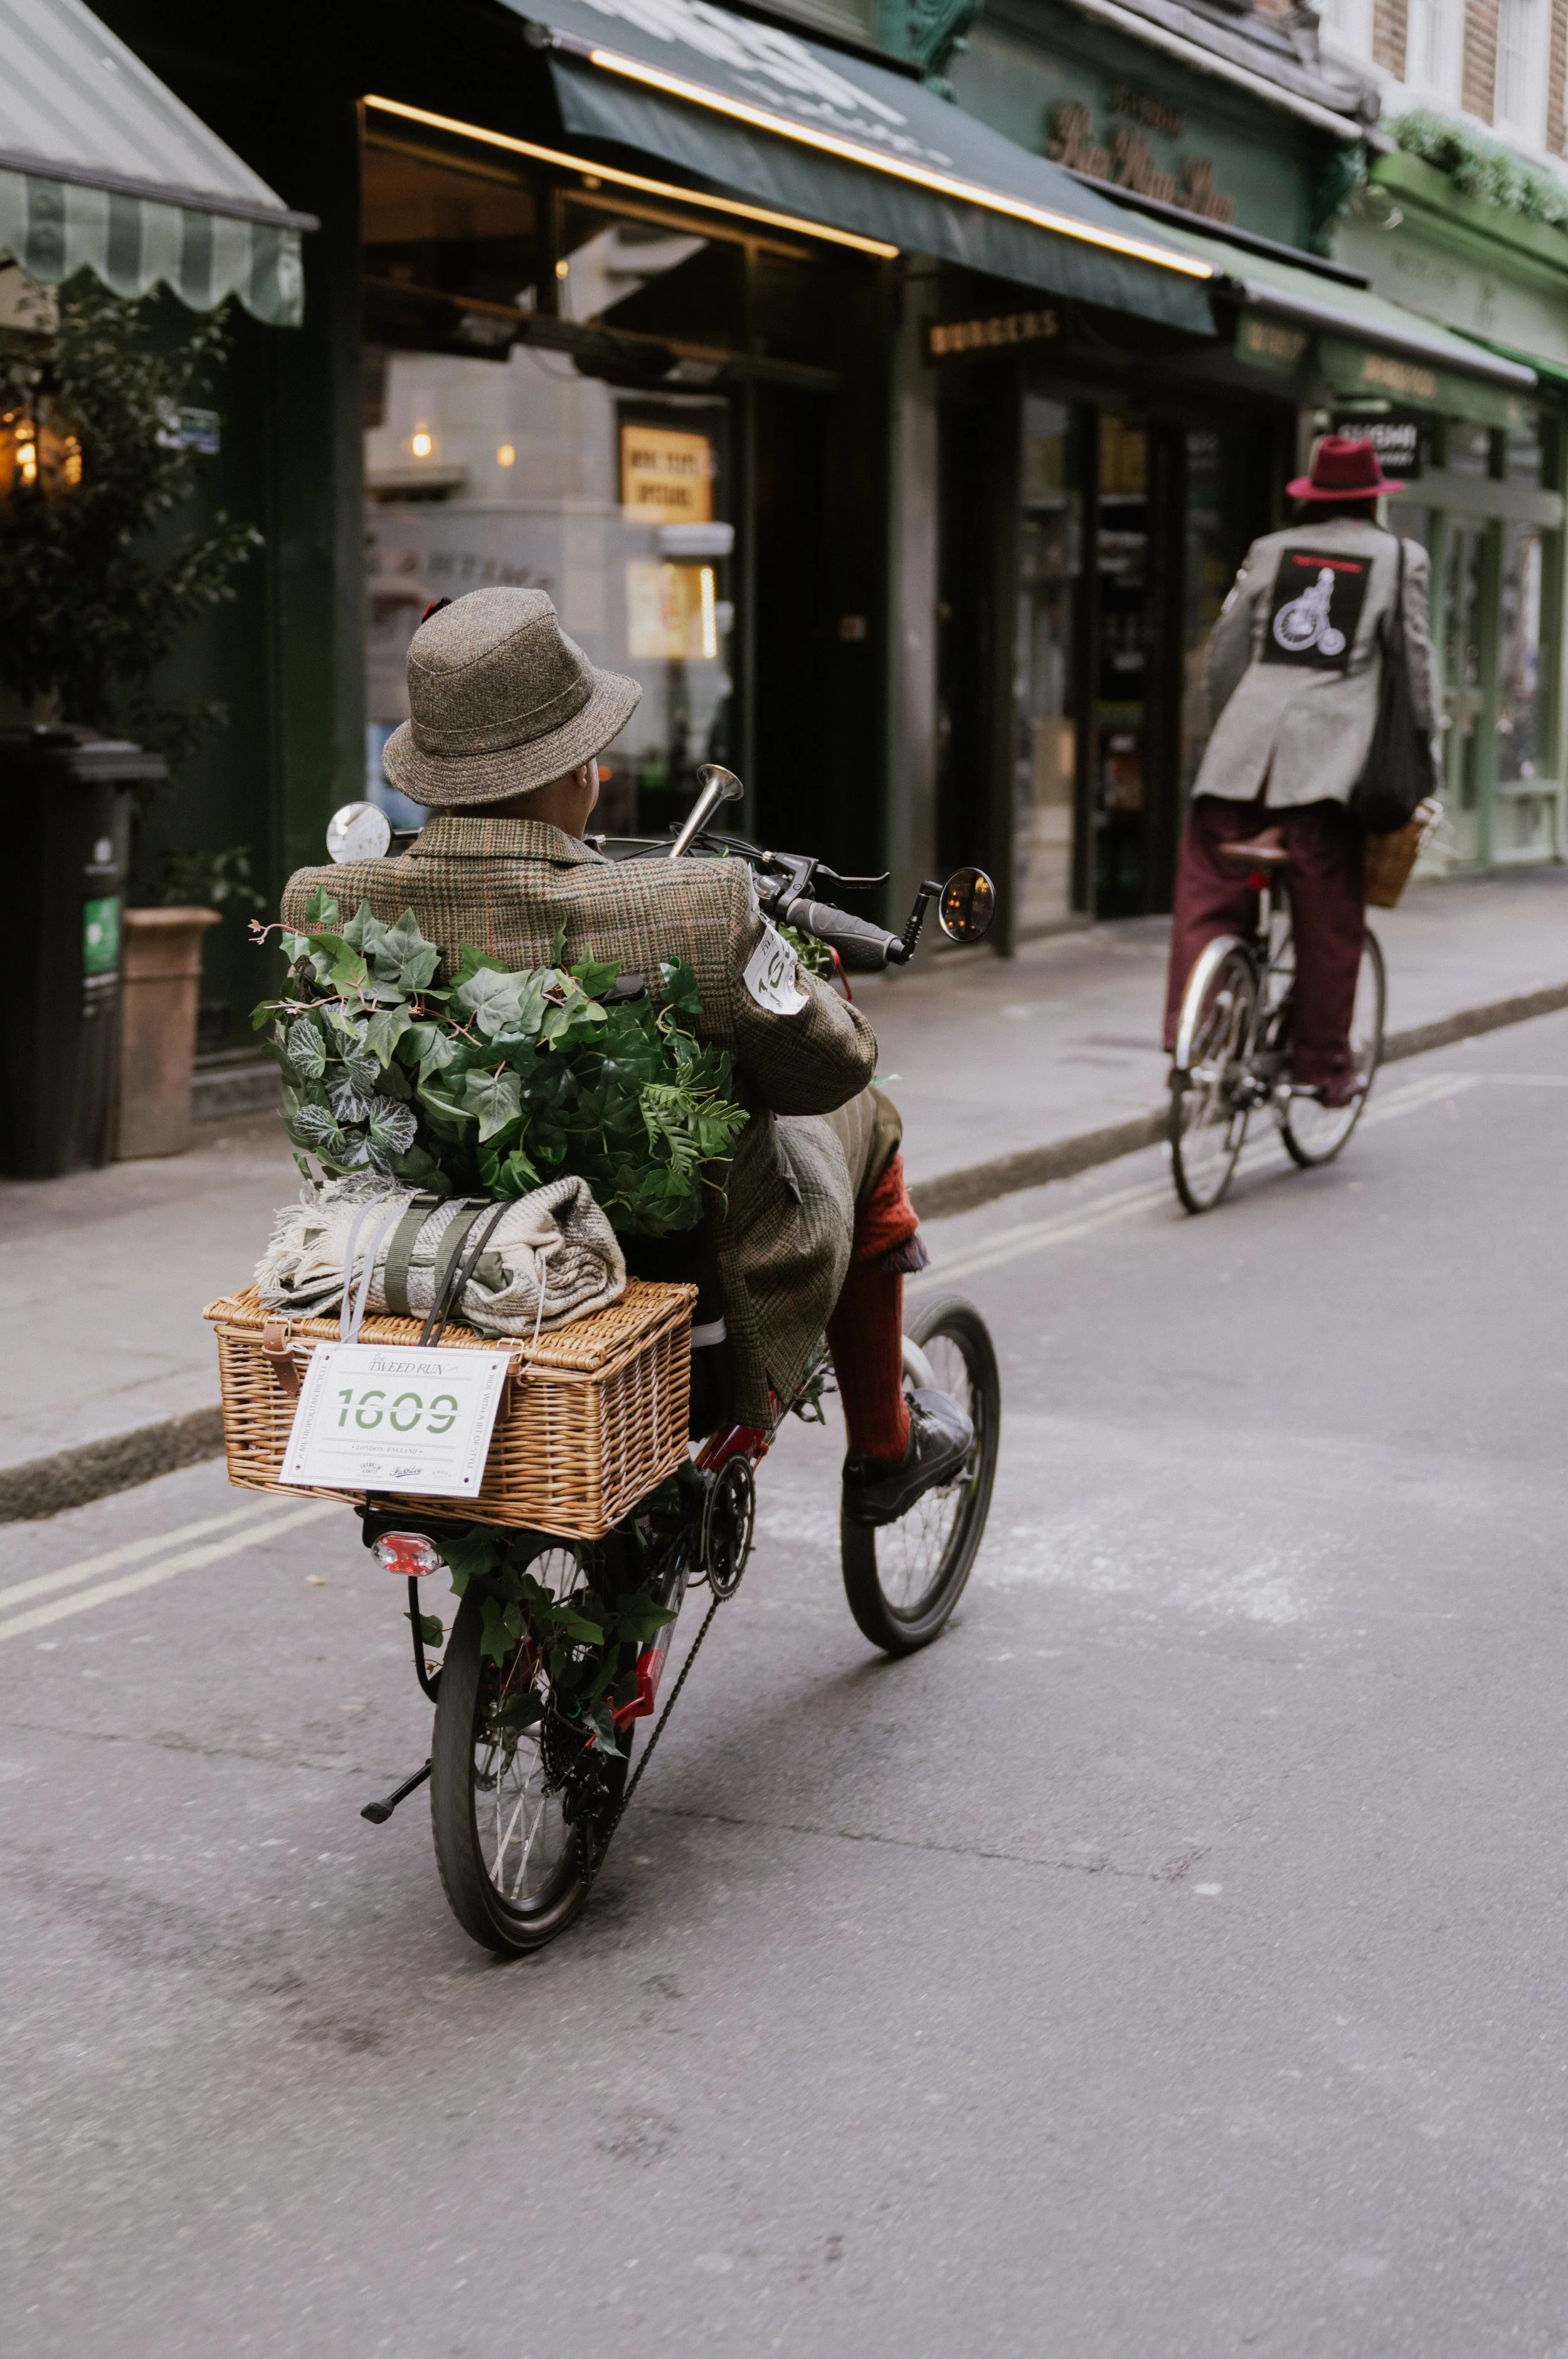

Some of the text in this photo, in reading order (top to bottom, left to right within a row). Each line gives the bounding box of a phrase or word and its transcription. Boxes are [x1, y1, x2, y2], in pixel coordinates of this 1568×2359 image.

[369, 1361, 449, 1376] TWEED RUN
[485, 1374, 495, 1391] RIDE
[337, 1388, 458, 1434] 1609
[480, 1393, 490, 1413] WITH
[299, 1394, 319, 1451] METROPOLITAN
[475, 1422, 484, 1434] BIT
[473, 1435, 480, 1446] OF
[386, 1446, 418, 1454] ENGLAND
[467, 1448, 477, 1470] STYLE
